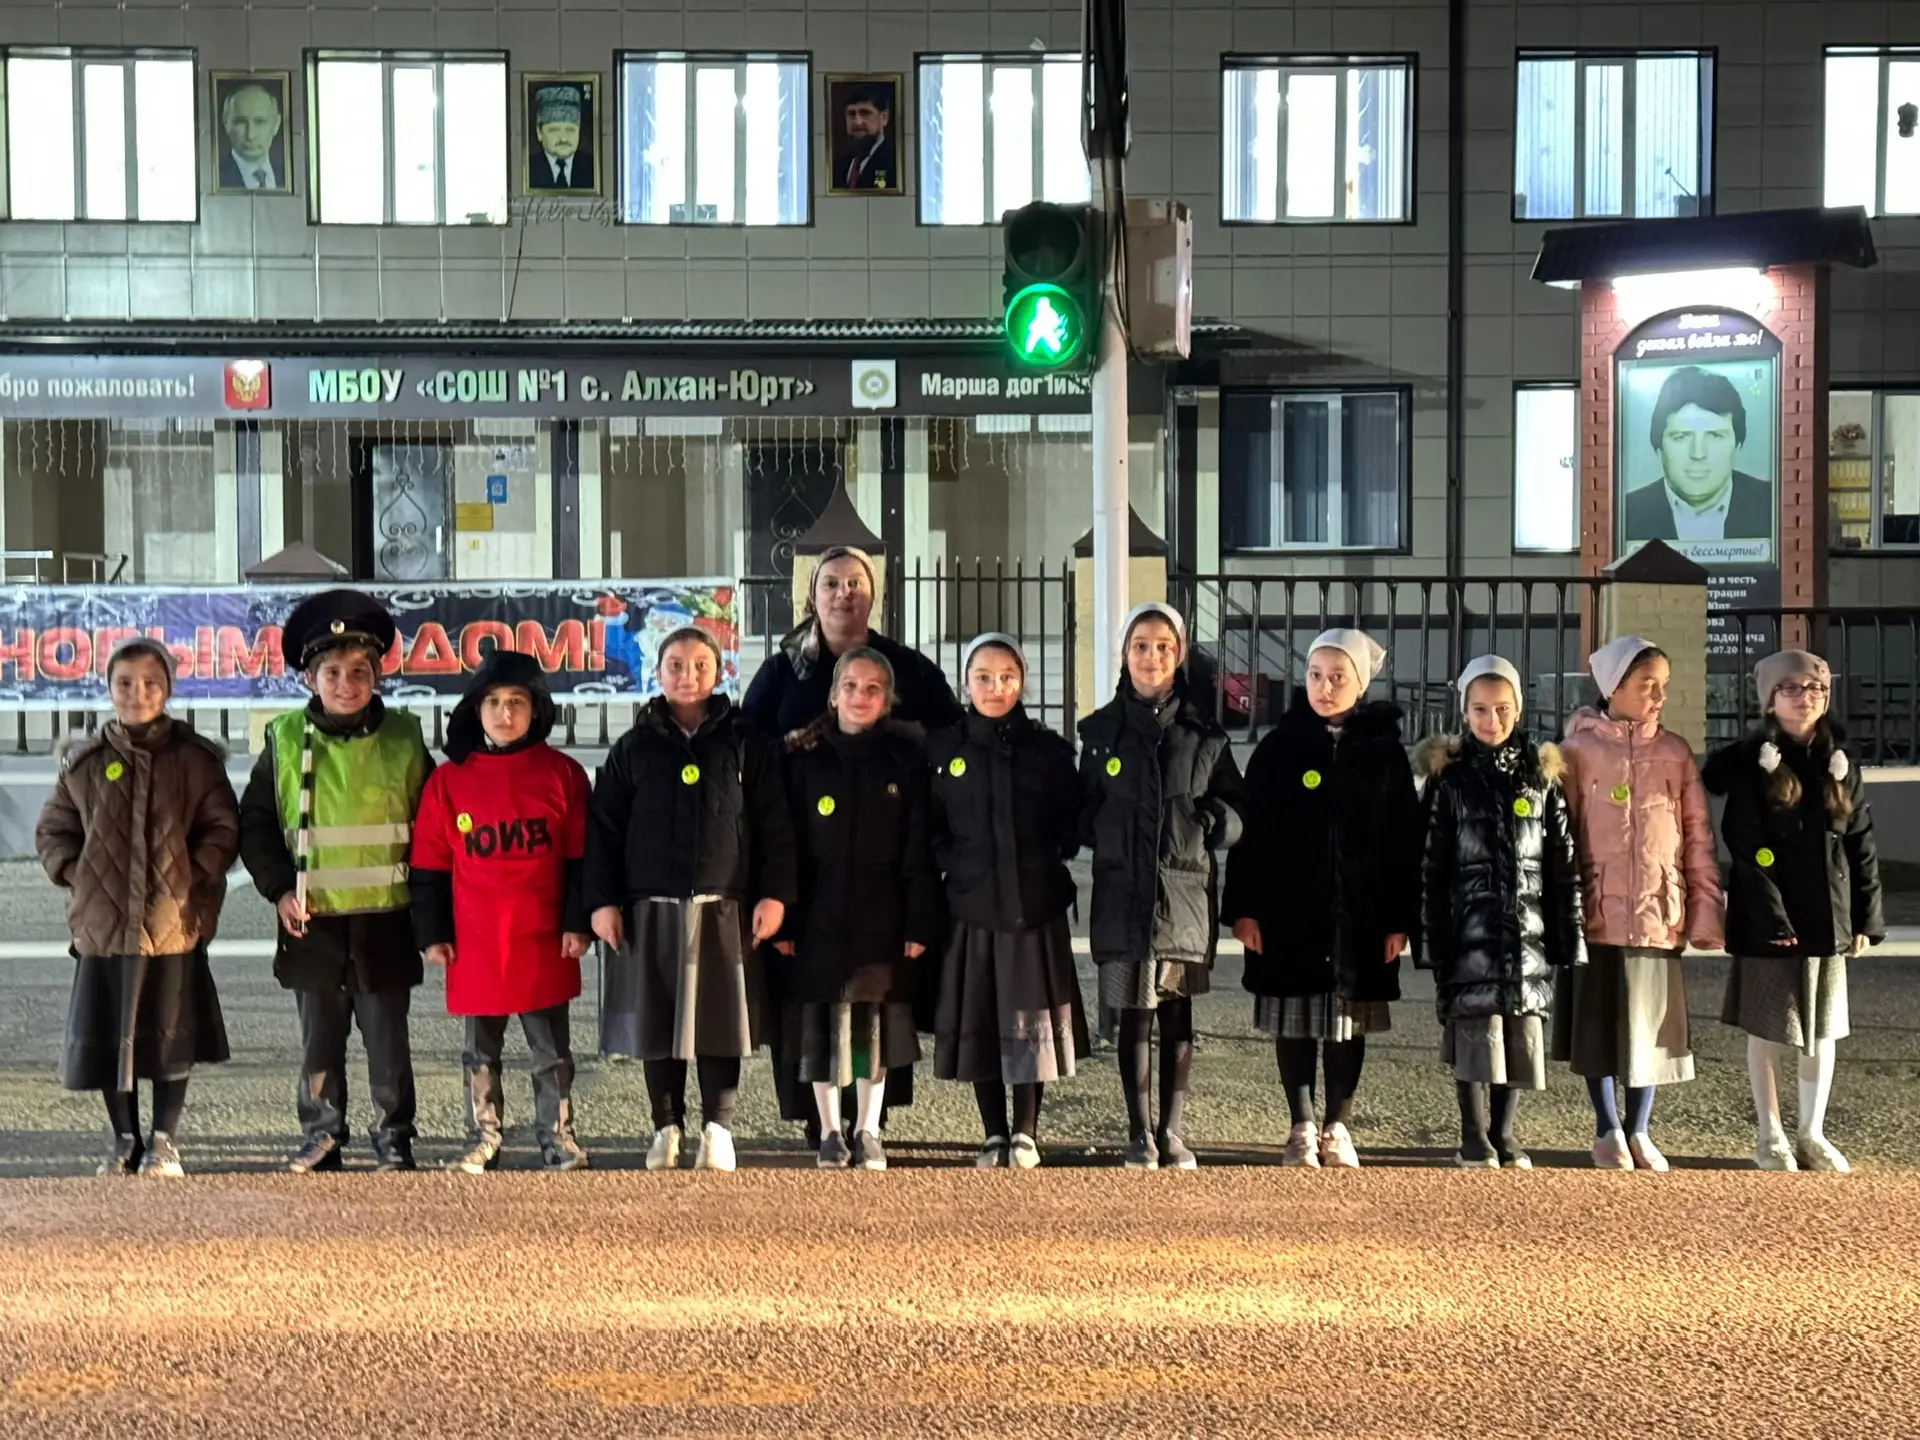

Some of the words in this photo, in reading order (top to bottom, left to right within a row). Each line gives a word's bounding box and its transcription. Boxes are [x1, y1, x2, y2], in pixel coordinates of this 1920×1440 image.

[47, 375, 196, 398] пожаловать!
[308, 368, 404, 403] МБОУ
[416, 369, 507, 402] «СОШ
[517, 369, 566, 402] №1
[580, 376, 610, 402] с.
[621, 369, 815, 406] Алхан-Юрт»
[921, 372, 1000, 400] Марша
[1691, 543, 1764, 560] бессмертно!
[1727, 576, 1757, 584] честь
[464, 817, 553, 858] ЮИД
